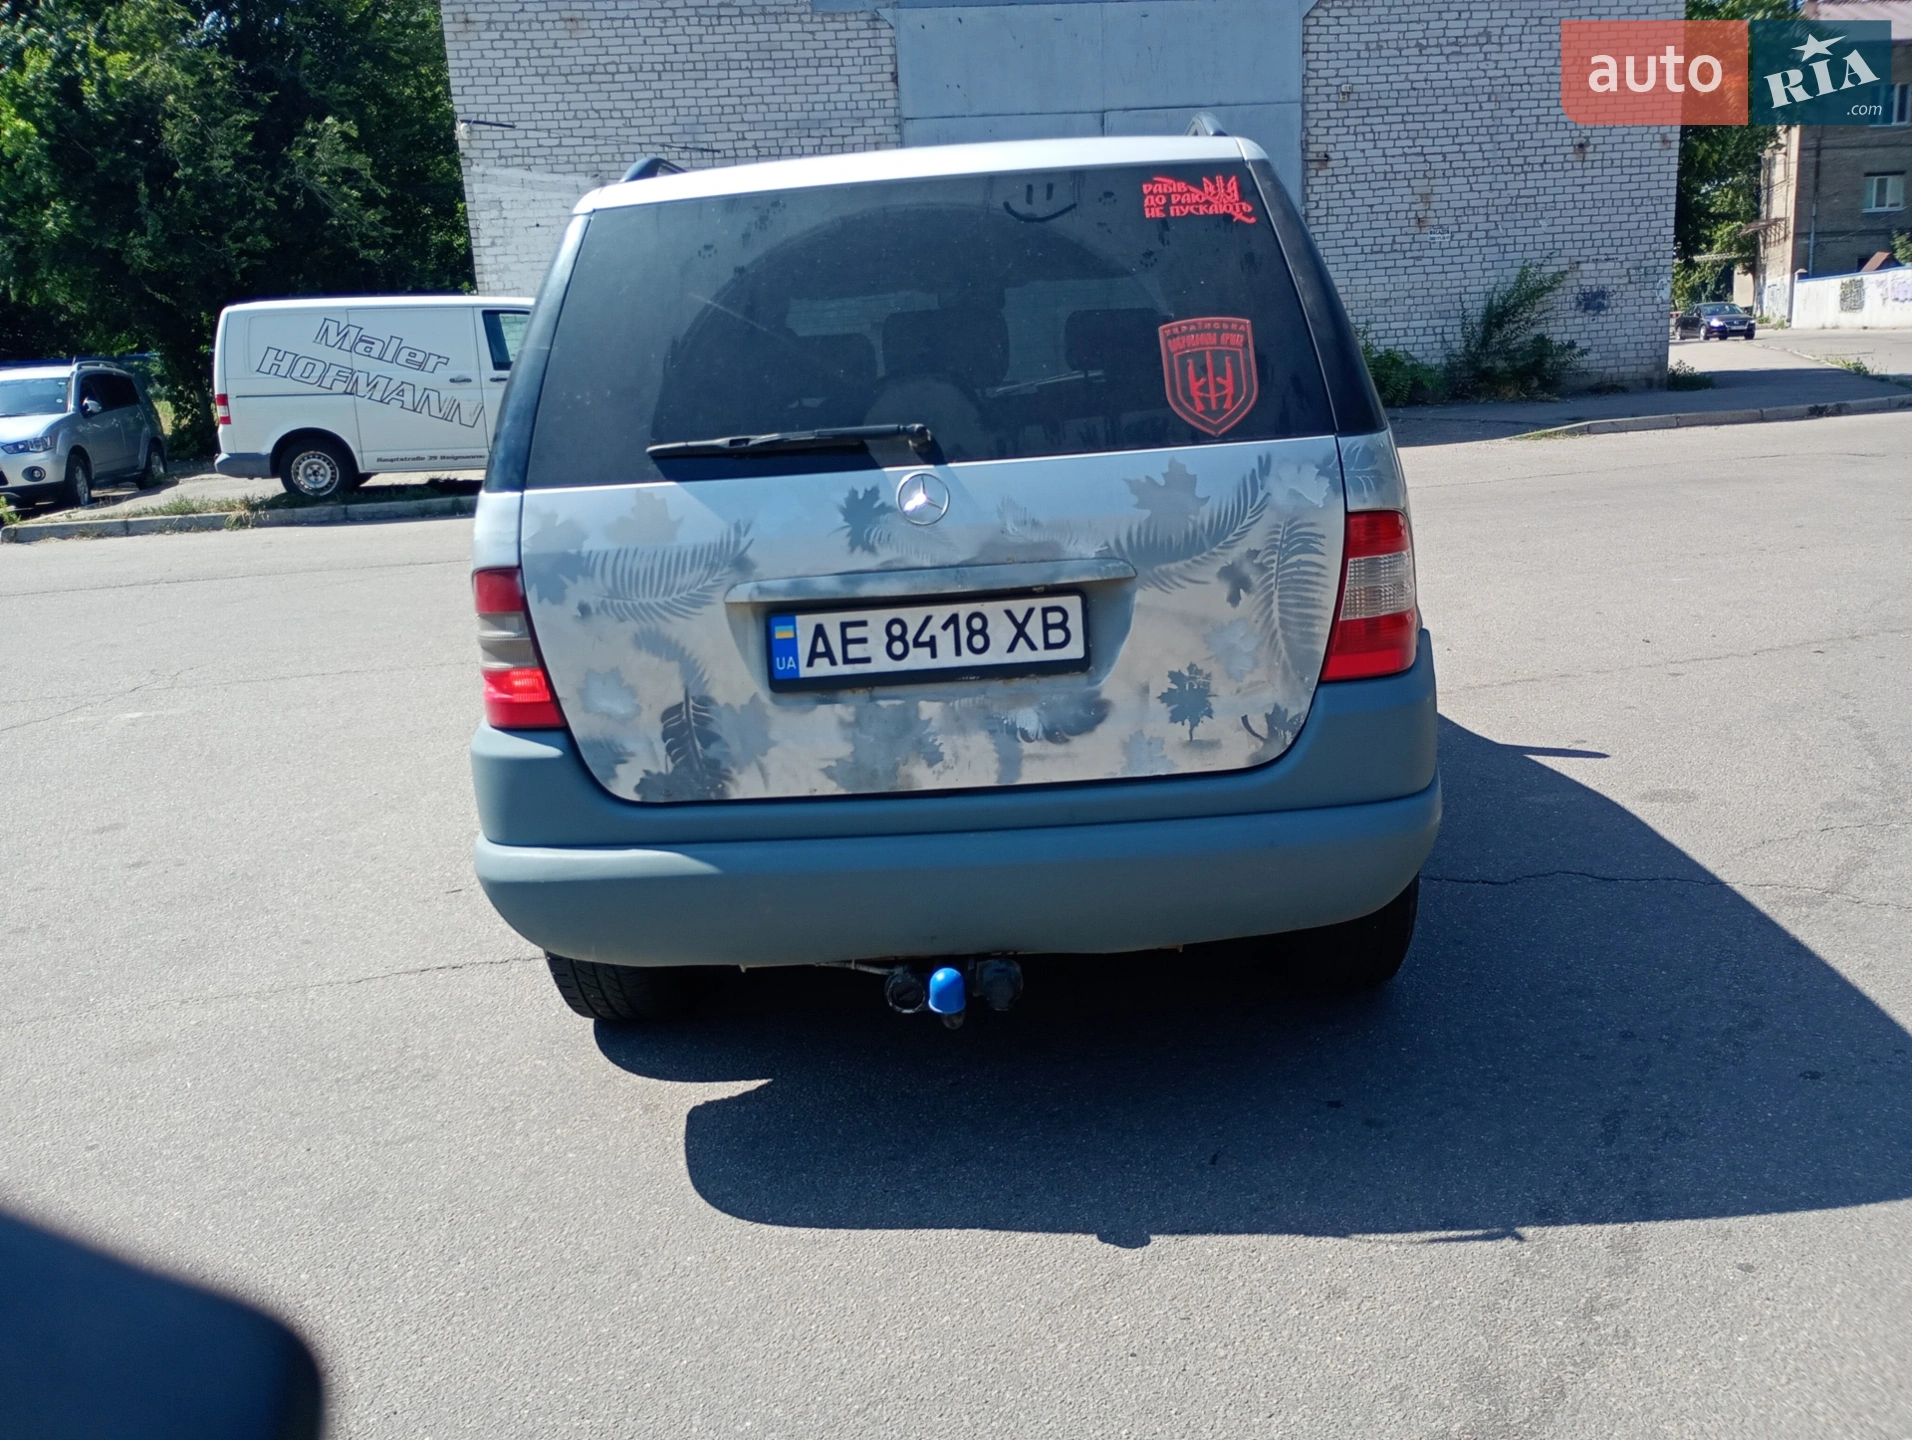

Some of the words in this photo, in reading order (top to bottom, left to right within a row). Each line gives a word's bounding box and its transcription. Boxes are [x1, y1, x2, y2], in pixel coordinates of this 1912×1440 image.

[1143, 194, 1167, 207] ДО
[1144, 206, 1166, 219] НЕ
[313, 317, 450, 374] Maler
[256, 346, 484, 428] HOFMANN
[806, 620, 872, 668] AE
[885, 611, 991, 662] 8418
[1004, 606, 1072, 654] XB
[776, 656, 796, 671] UA
